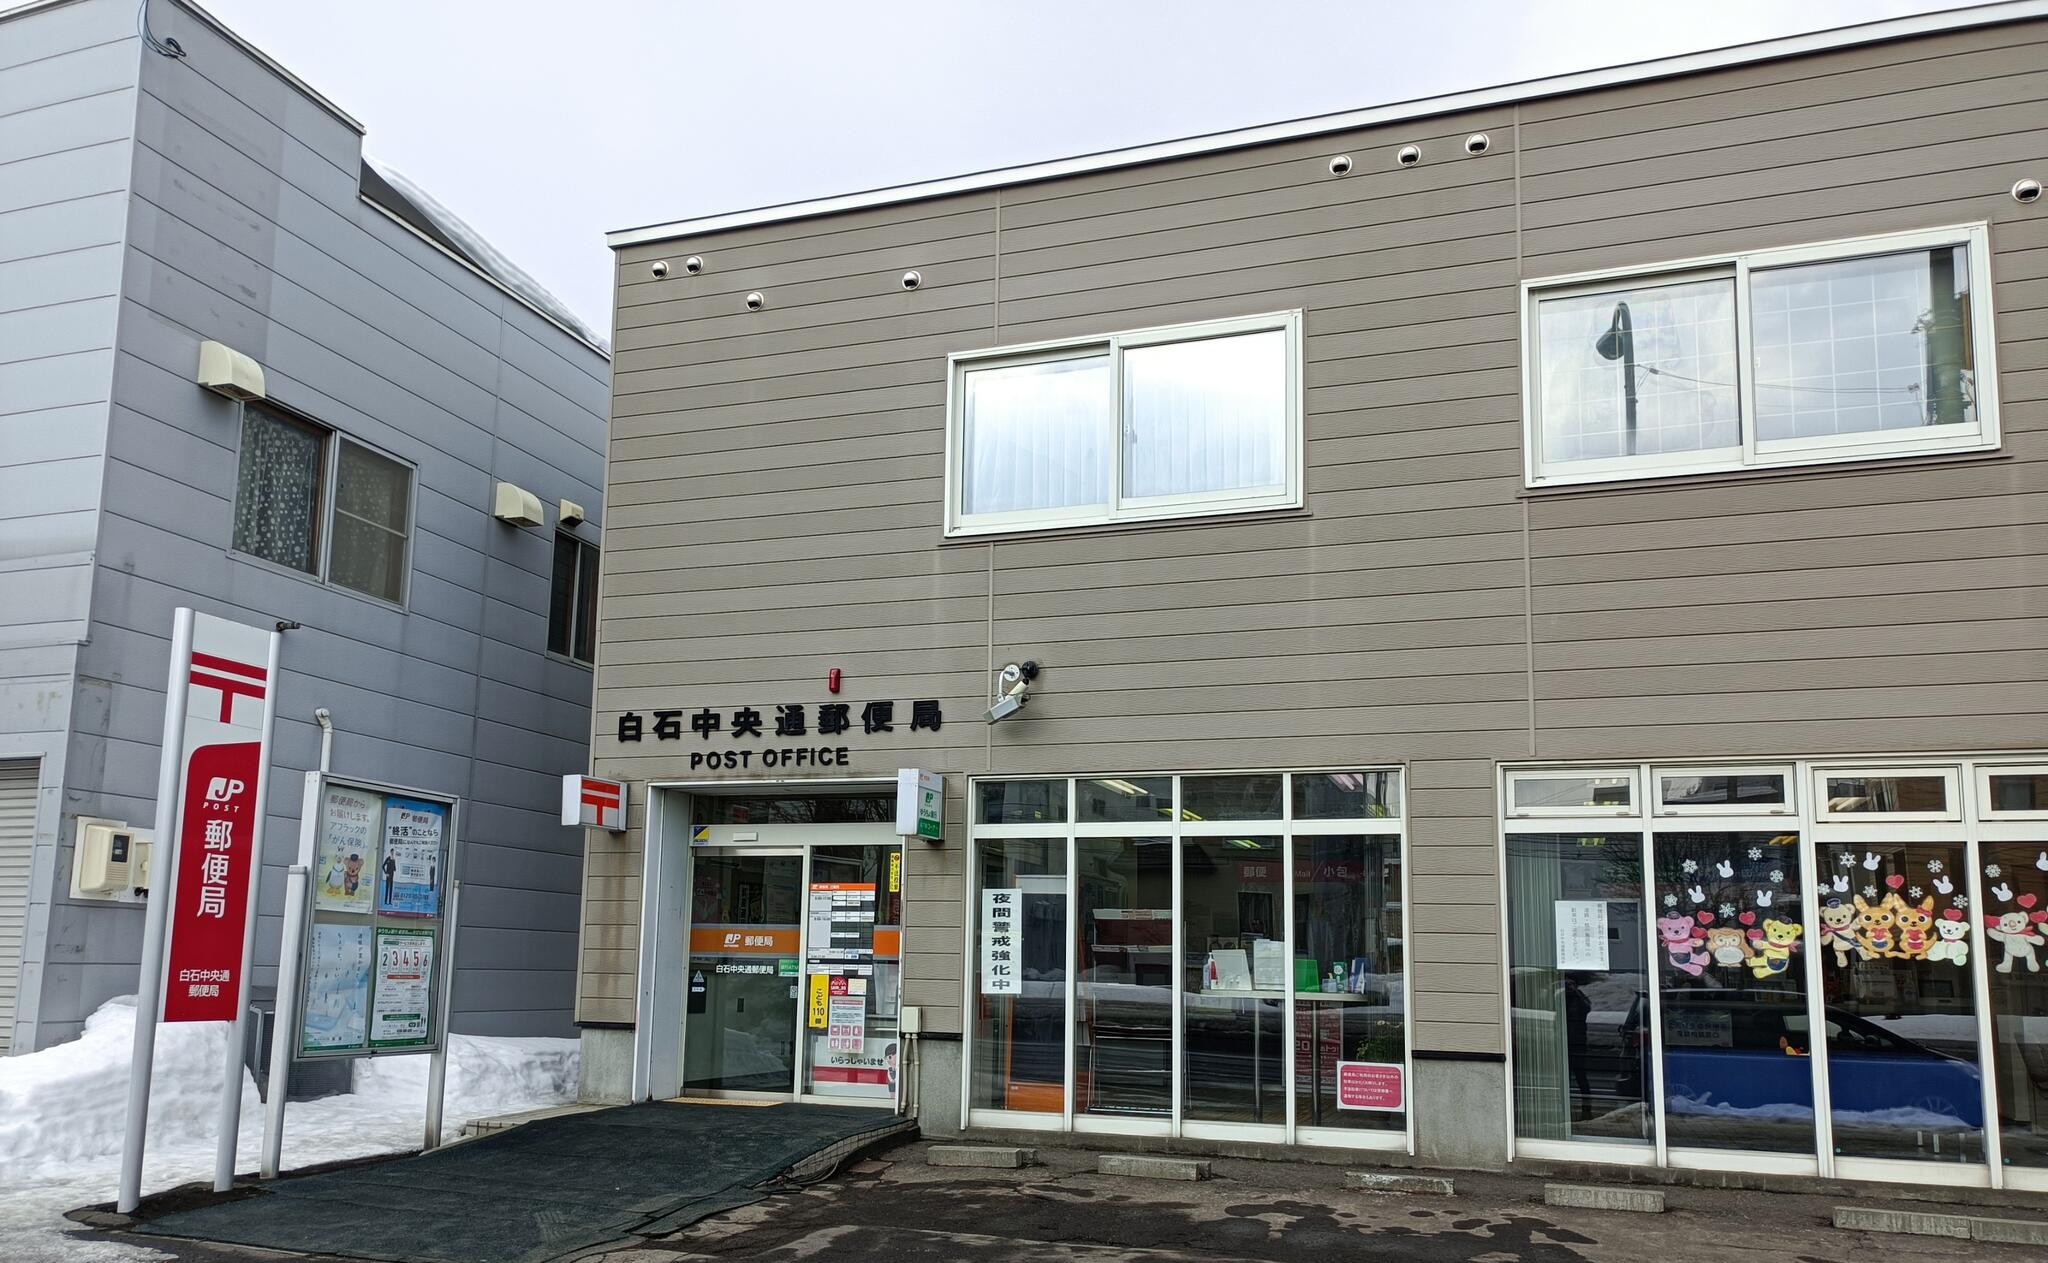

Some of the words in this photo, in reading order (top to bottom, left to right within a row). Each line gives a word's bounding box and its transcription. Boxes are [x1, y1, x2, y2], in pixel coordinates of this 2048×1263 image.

[618, 700, 943, 743] 白石中央通郵便局
[690, 750, 752, 770] POST
[762, 747, 849, 769] OFFICE
[203, 802, 240, 813] POST
[197, 820, 233, 918] 郵便局
[745, 936, 774, 947] 郵便局
[991, 893, 1012, 990] 夜間警戒強化中
[383, 953, 388, 967] 2
[392, 950, 399, 967] 3
[403, 950, 409, 967] 4
[413, 951, 419, 967] 5
[423, 954, 428, 967] 6
[179, 969, 230, 982] 白石中央通
[716, 964, 774, 974] 白石中央通郵便局
[188, 984, 219, 997] 郵便局
[831, 1056, 884, 1066] いらっしゃいませ
